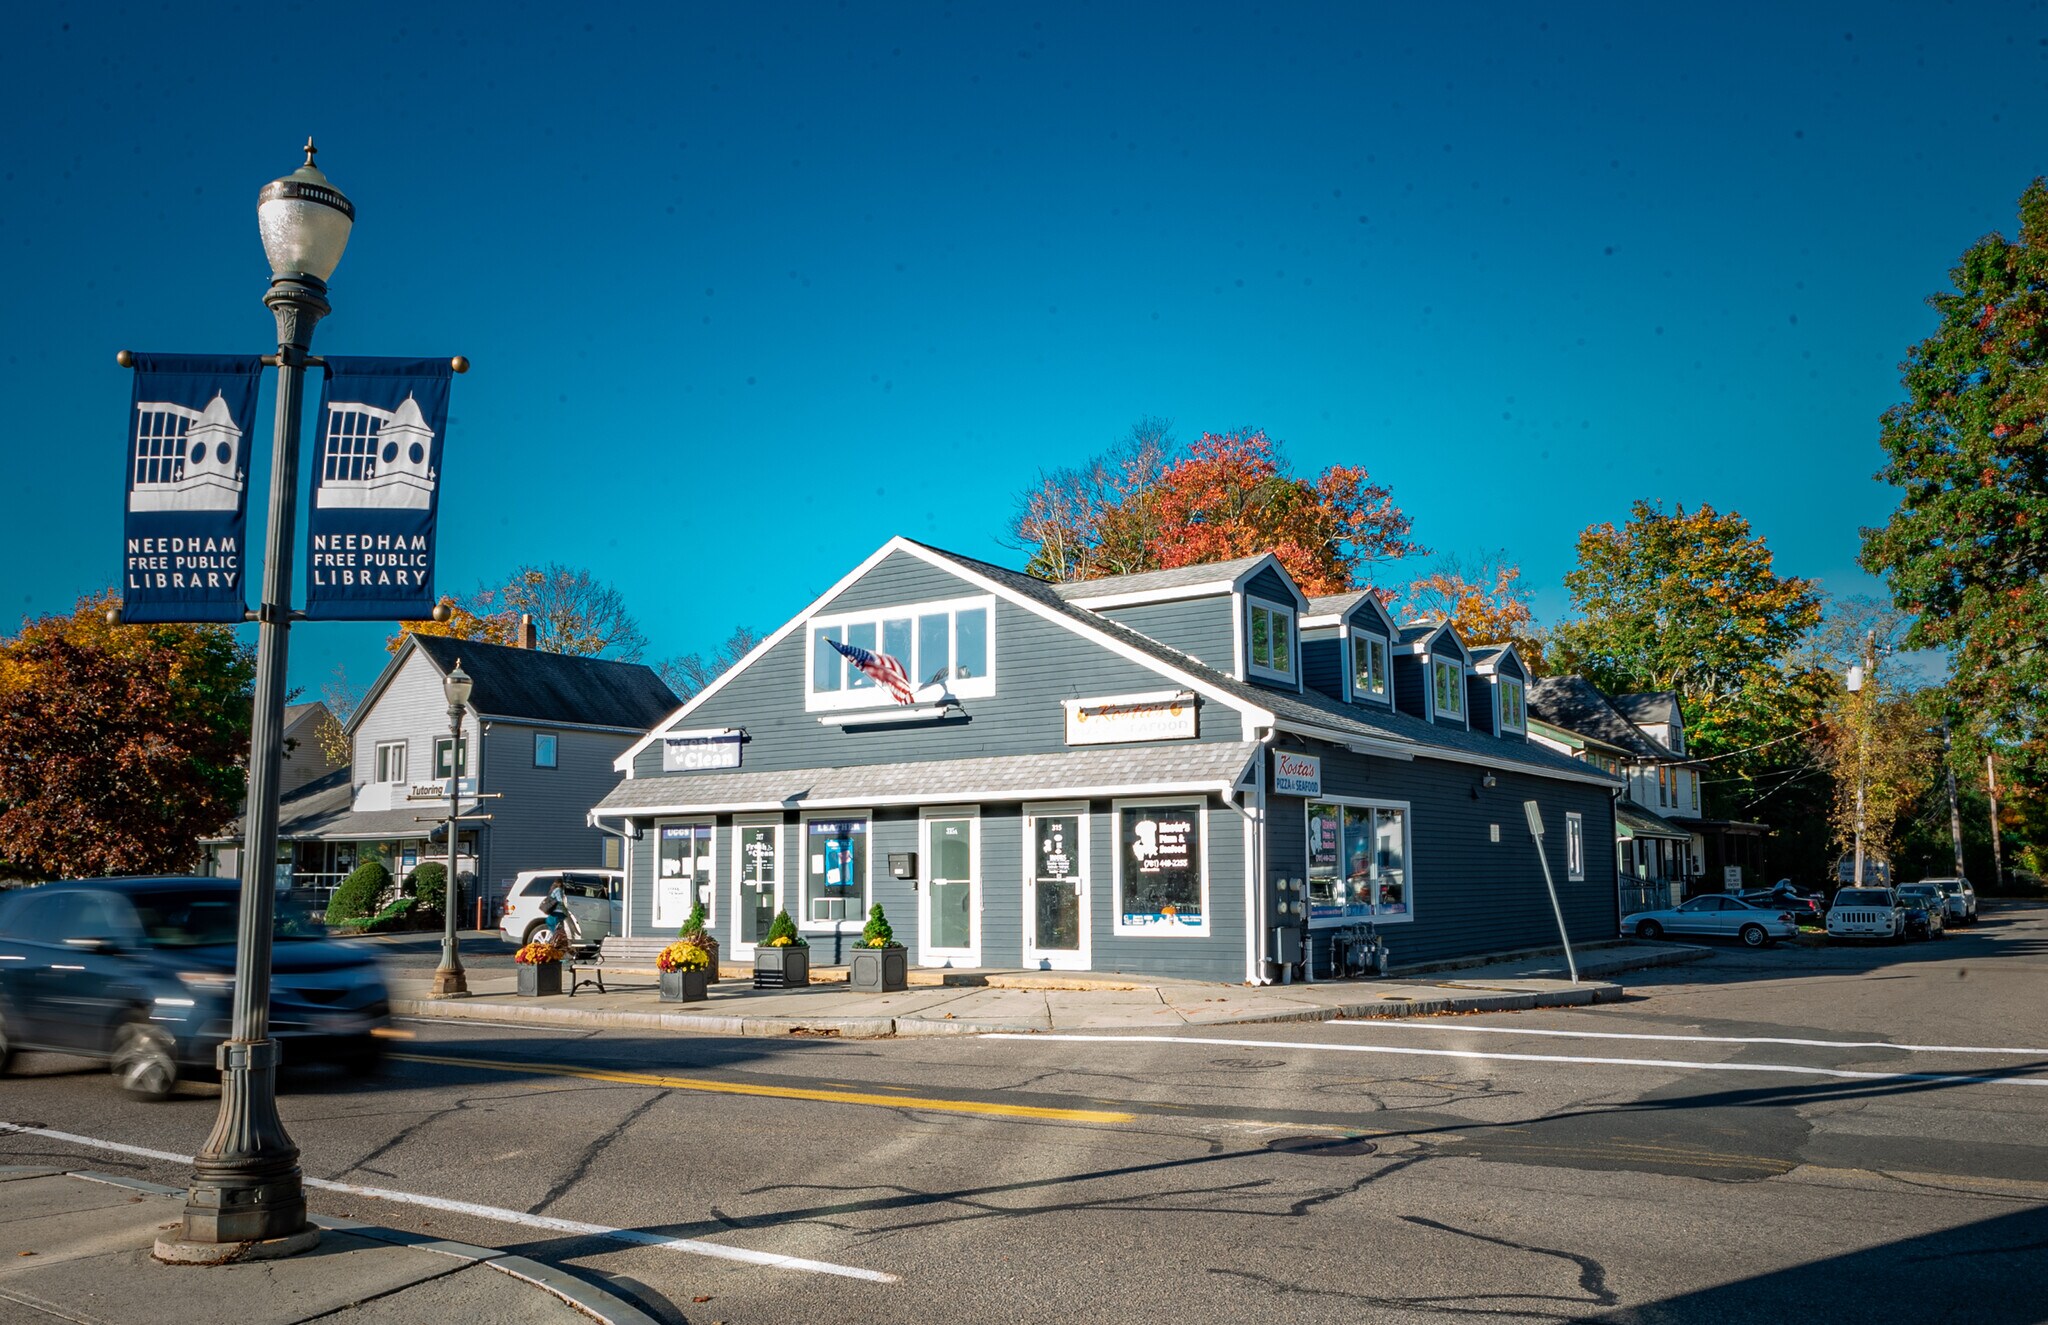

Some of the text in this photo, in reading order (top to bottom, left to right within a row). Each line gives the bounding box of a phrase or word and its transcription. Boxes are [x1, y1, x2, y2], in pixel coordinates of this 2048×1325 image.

[129, 537, 236, 554] NEEDHAM
[314, 534, 427, 551] NEEDHAM
[129, 556, 237, 570] FREE PUBLIC
[314, 553, 427, 567] FREE PUBLIC
[130, 572, 236, 589] LIBRARY
[314, 570, 426, 586] LIBRARY
[1097, 704, 1164, 722] Kosta's
[684, 751, 734, 768] Clean
[1279, 754, 1315, 777] Kosta's
[412, 784, 443, 796] Tutoring
[1276, 778, 1291, 789] PIZZA
[1296, 780, 1319, 792] SEAFOOD
[817, 823, 860, 831] LEATHER
